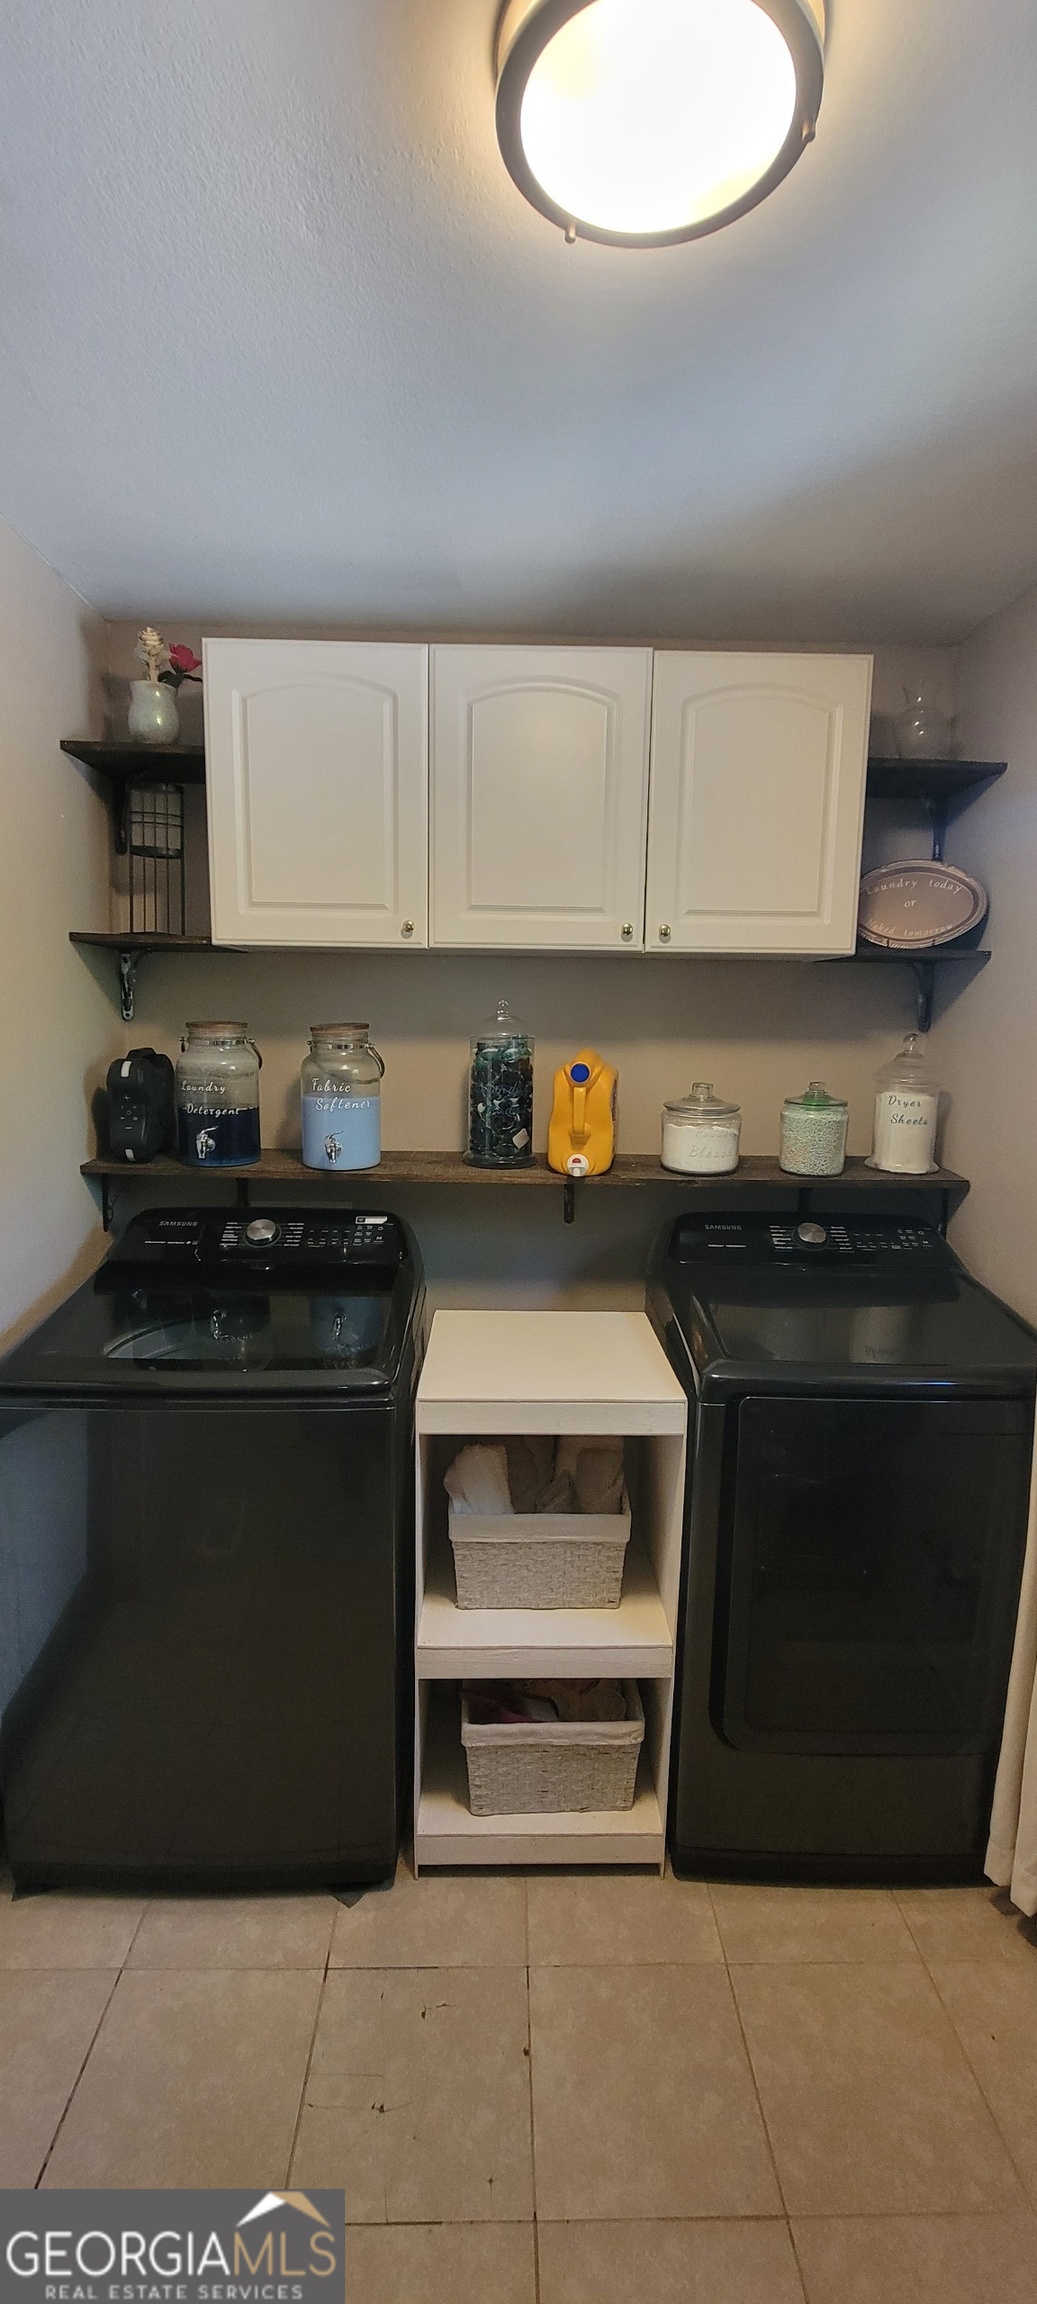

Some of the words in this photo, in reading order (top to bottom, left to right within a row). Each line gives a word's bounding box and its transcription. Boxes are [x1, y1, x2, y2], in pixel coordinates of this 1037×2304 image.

[866, 879, 918, 895] Laundry
[929, 879, 962, 895] today
[904, 899, 917, 908] or
[904, 923, 954, 937] tomorrow
[181, 1080, 226, 1095] Laundry
[311, 1077, 352, 1093] Fabric
[315, 1096, 371, 1112] Softener
[888, 1094, 922, 1108] Dryer
[186, 1102, 240, 1118] Detergent
[890, 1113, 928, 1126] Sheets
